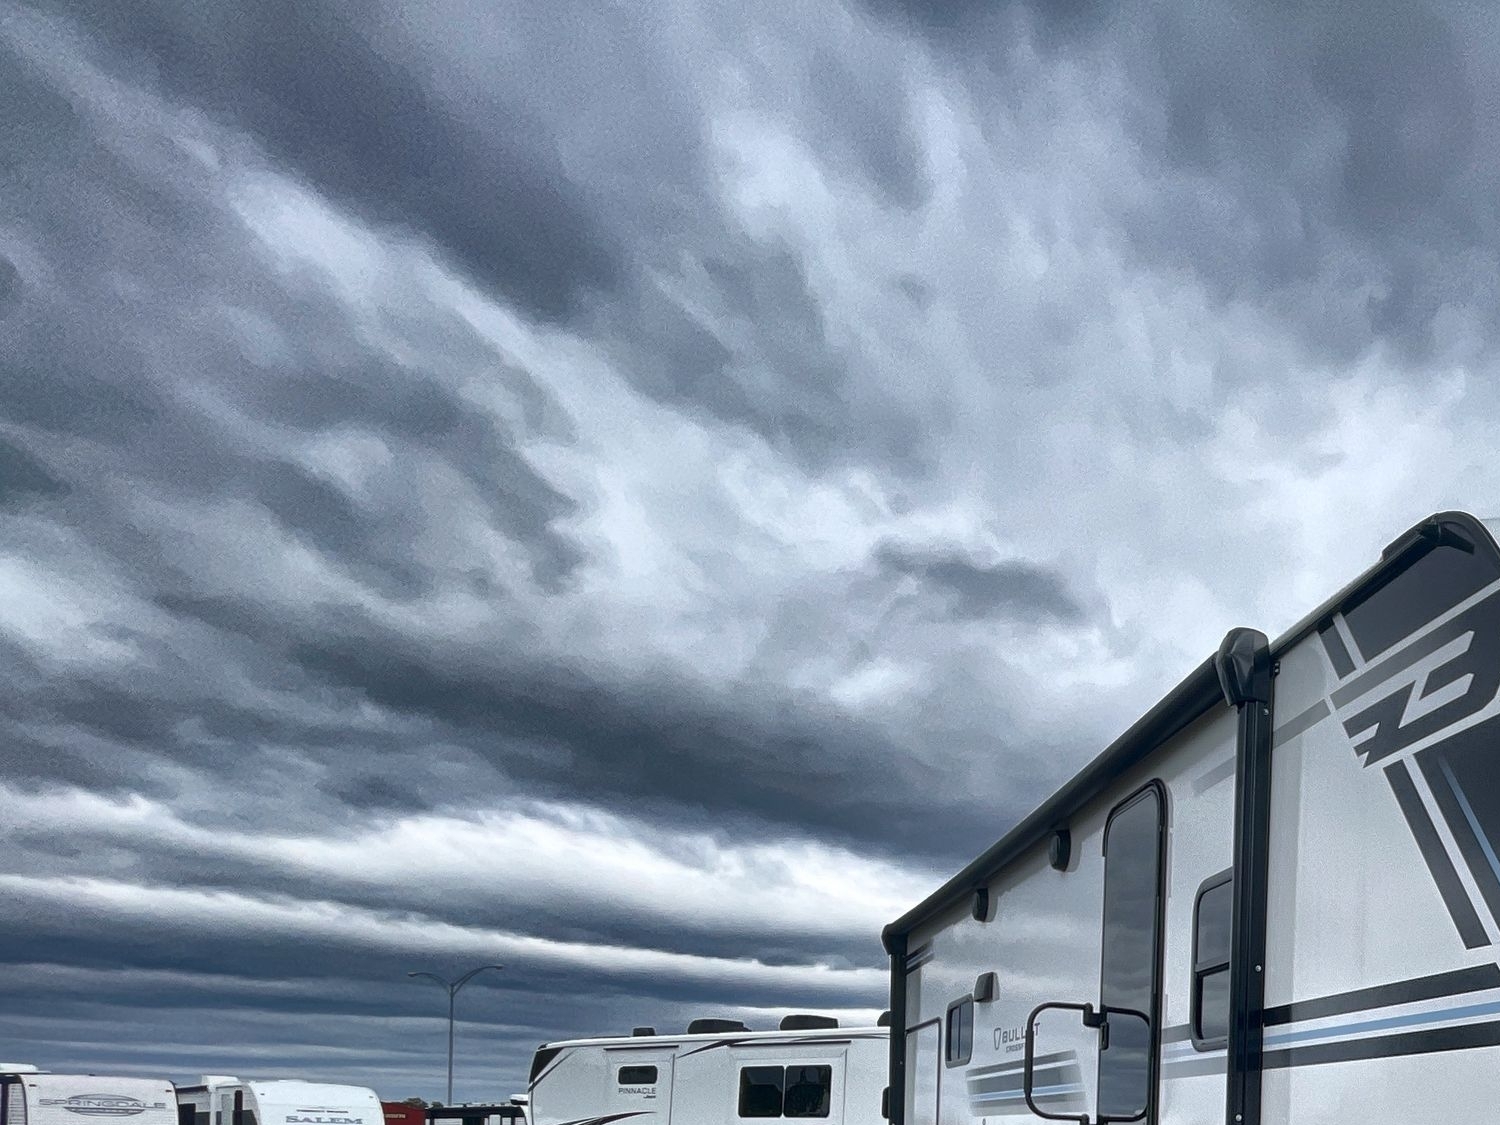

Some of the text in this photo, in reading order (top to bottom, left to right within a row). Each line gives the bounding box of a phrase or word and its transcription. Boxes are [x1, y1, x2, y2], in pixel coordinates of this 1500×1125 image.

[1002, 1022, 1041, 1044] BULLT
[618, 1087, 657, 1095] PINNACLE
[285, 1115, 363, 1125] SALEM
